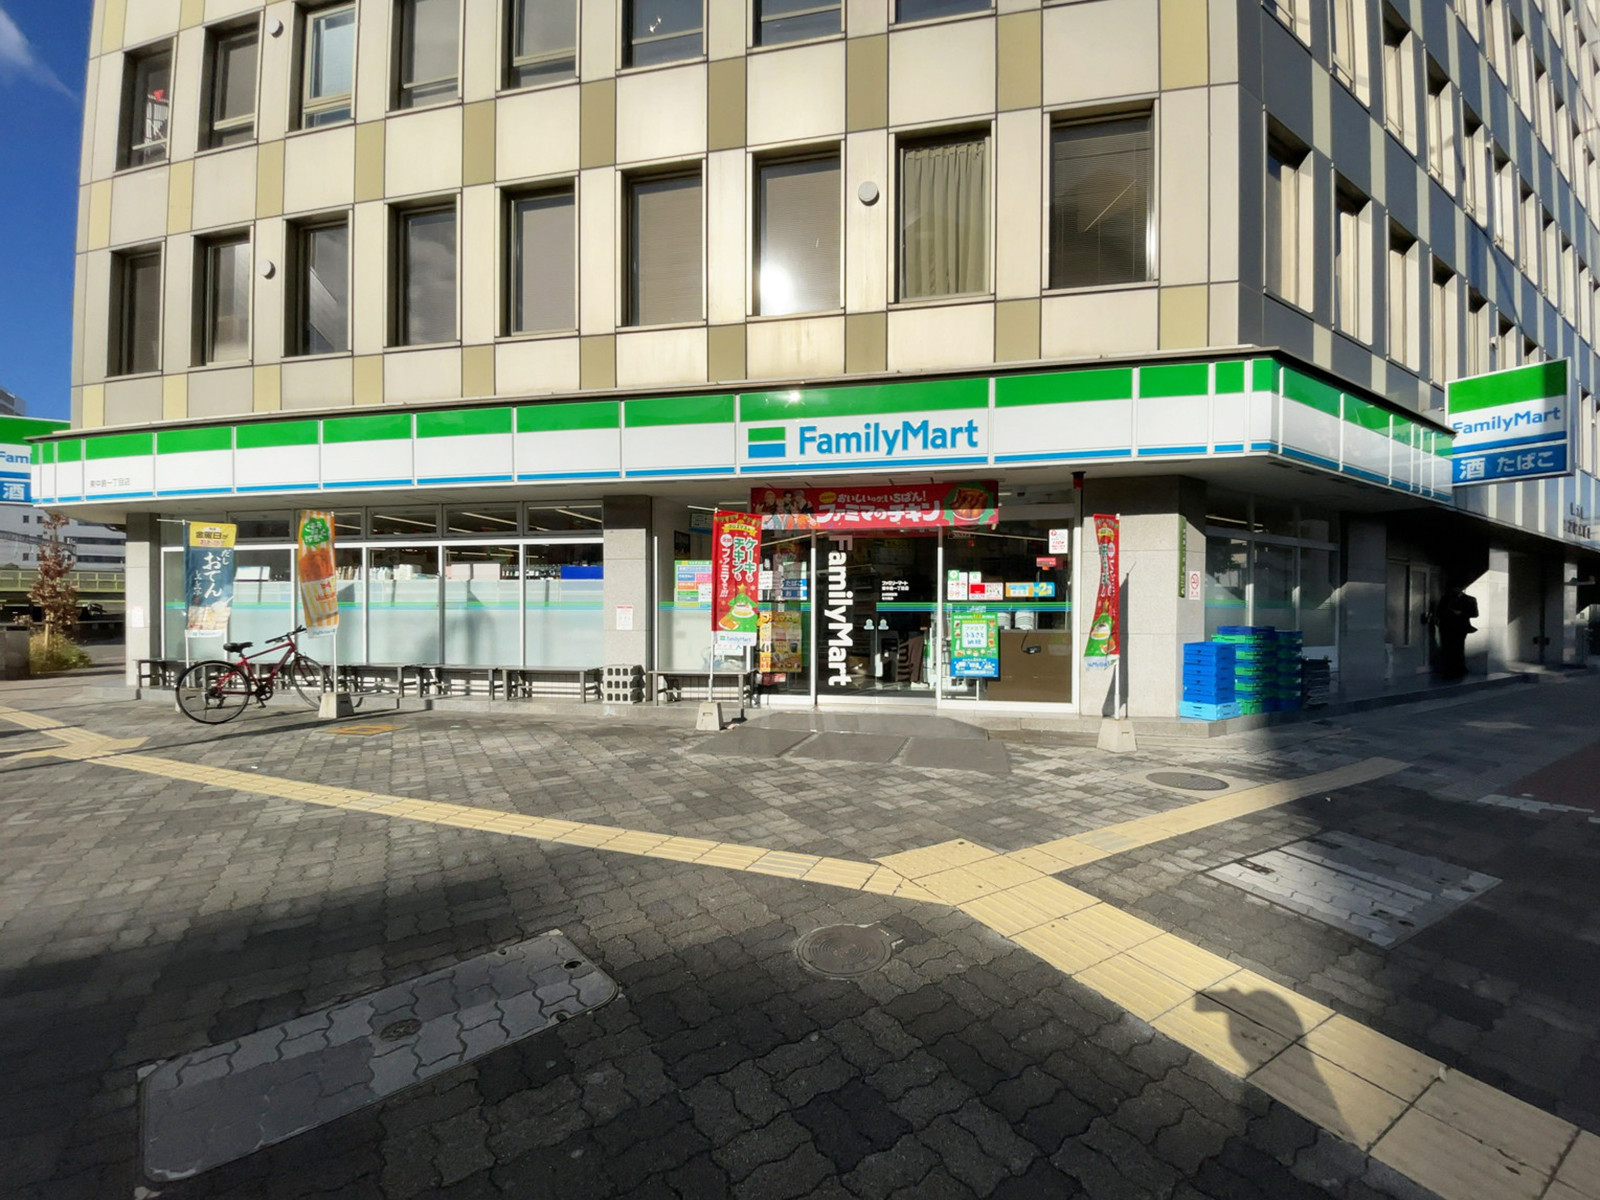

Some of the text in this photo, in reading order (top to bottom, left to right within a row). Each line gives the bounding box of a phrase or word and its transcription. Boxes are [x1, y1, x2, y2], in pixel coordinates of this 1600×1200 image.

[1453, 407, 1561, 434] FamilyMart
[799, 419, 979, 456] FamilyMart
[1459, 452, 1554, 479] 酒 たばこ
[2, 482, 26, 500] 酒
[816, 500, 941, 523] ファミマのチキン
[732, 537, 745, 580] チキンも
[744, 537, 758, 581] ケーキも
[824, 535, 854, 686] FamilyMart
